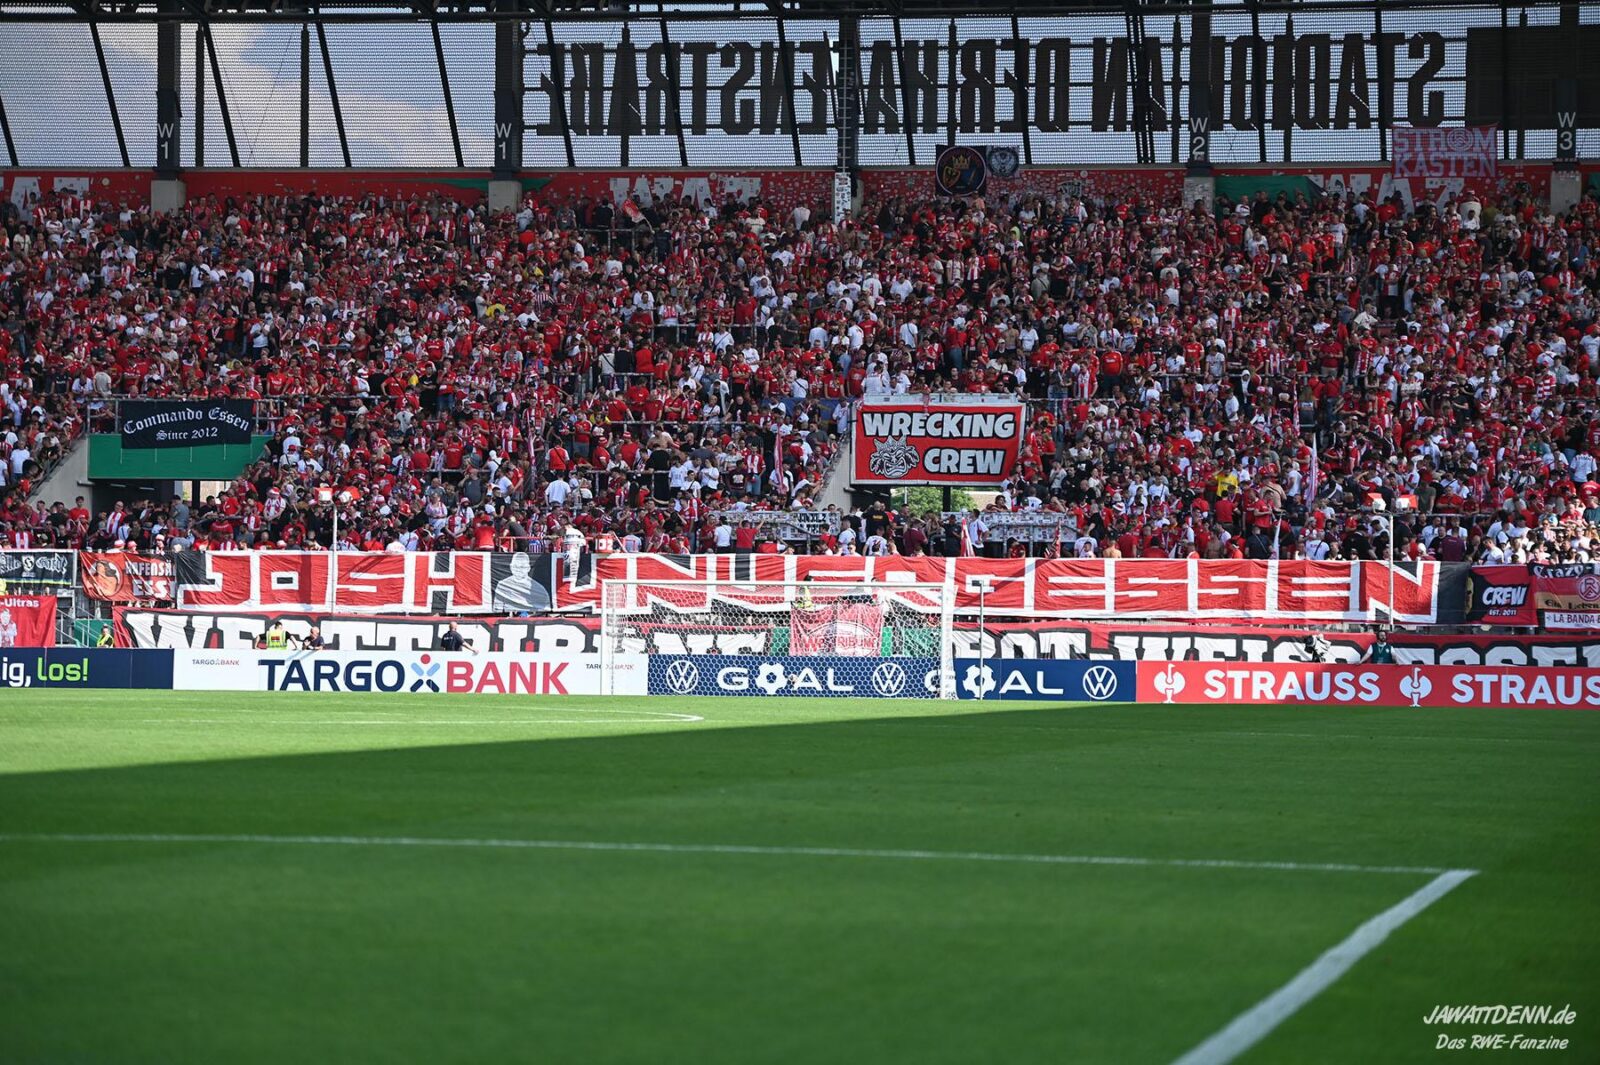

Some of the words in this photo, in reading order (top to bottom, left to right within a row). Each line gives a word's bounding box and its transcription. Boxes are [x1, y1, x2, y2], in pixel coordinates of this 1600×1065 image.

[1190, 117, 1208, 133] W
[1557, 112, 1575, 128] W
[158, 122, 174, 138] W
[495, 122, 512, 138] W
[1193, 136, 1206, 151] 2
[1559, 133, 1573, 150] 3
[161, 142, 169, 159] 1
[499, 142, 507, 159] 1
[1393, 152, 1496, 177] KASTEN
[123, 407, 203, 434] Commando
[208, 406, 249, 431] Essen
[862, 412, 1015, 438] WRECKING
[156, 429, 188, 440] Since
[191, 427, 218, 438] 2012
[924, 448, 1005, 474] CREW
[177, 551, 492, 613] JOSH
[1482, 585, 1528, 606] CREW
[1553, 614, 1565, 623] LA
[1567, 614, 1595, 623] BANDA
[1392, 645, 1600, 668] ESSE
[2, 656, 31, 687] ig,
[37, 657, 89, 681] los!
[1204, 669, 1380, 702] STRAUSS
